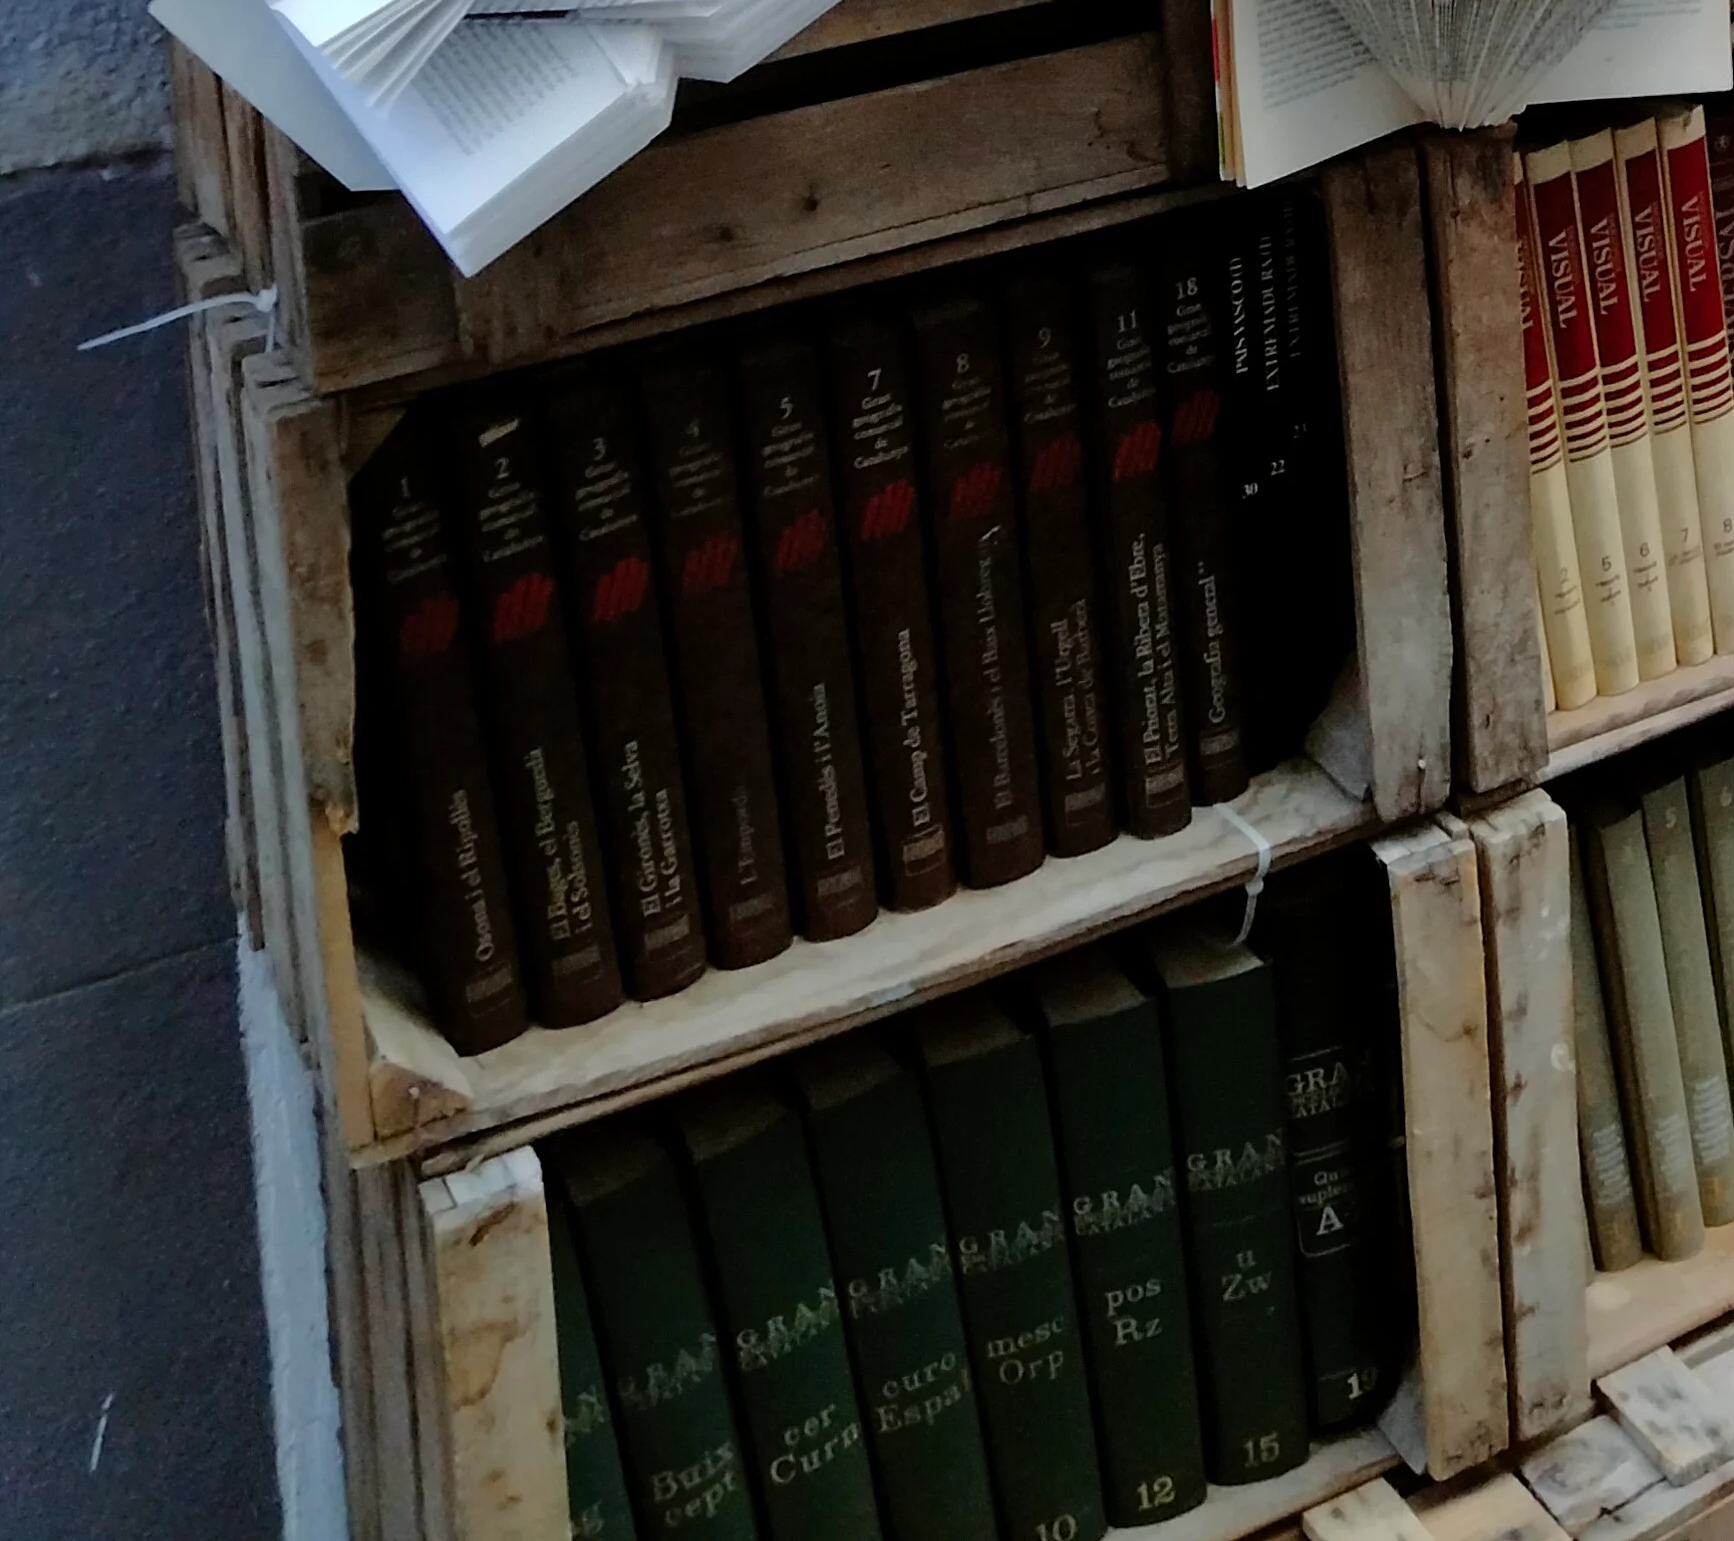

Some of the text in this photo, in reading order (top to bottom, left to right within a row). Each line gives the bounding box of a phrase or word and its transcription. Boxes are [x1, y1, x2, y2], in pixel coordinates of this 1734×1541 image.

[1634, 205, 1661, 302] VISUAL
[1680, 194, 1707, 293] VISUAL
[1548, 230, 1577, 329] VISUAL
[1590, 217, 1618, 316] VISUAL
[1174, 277, 1198, 300] 18
[1037, 327, 1051, 349] 9
[1116, 310, 1136, 333] 11
[1259, 258, 1280, 392] EXTREMADURA
[867, 367, 882, 392] 7
[956, 353, 969, 373] 8
[780, 395, 794, 419] 5
[493, 457, 509, 479] 2
[593, 437, 607, 460] 3
[1270, 459, 1286, 477] 22
[1681, 528, 1689, 543] 7
[1723, 518, 1732, 533] 8
[1602, 556, 1611, 571] 5
[1640, 543, 1650, 557] 6
[1127, 533, 1162, 765] El la Ribera d'Ebre,
[1152, 543, 1180, 758] Terra Alta el Matarranya
[1203, 639, 1227, 724] Geografia
[897, 628, 930, 827] El Camp de Tarragona
[1082, 691, 1098, 747] Conca
[1066, 759, 1082, 780] La
[621, 740, 662, 916] El Gironès, la Selva
[817, 765, 845, 861] El Penedès
[523, 747, 571, 941] El el Berguedà
[655, 788, 681, 897] la Garrotxa
[448, 789, 494, 962] Osona Ripollès
[562, 820, 591, 920] el Solsonès
[1186, 1133, 1281, 1172] GRAN
[1073, 1168, 1174, 1216] GRAN
[1316, 1206, 1343, 1235] A
[1105, 1277, 1162, 1317] pos
[1221, 1271, 1272, 1302] Zw
[1113, 1316, 1163, 1346] Rz
[882, 1353, 957, 1399] curo
[1000, 1350, 1064, 1385] Orp
[784, 1404, 836, 1446] cer
[1243, 1433, 1280, 1467] 15
[1135, 1476, 1177, 1510] 12
